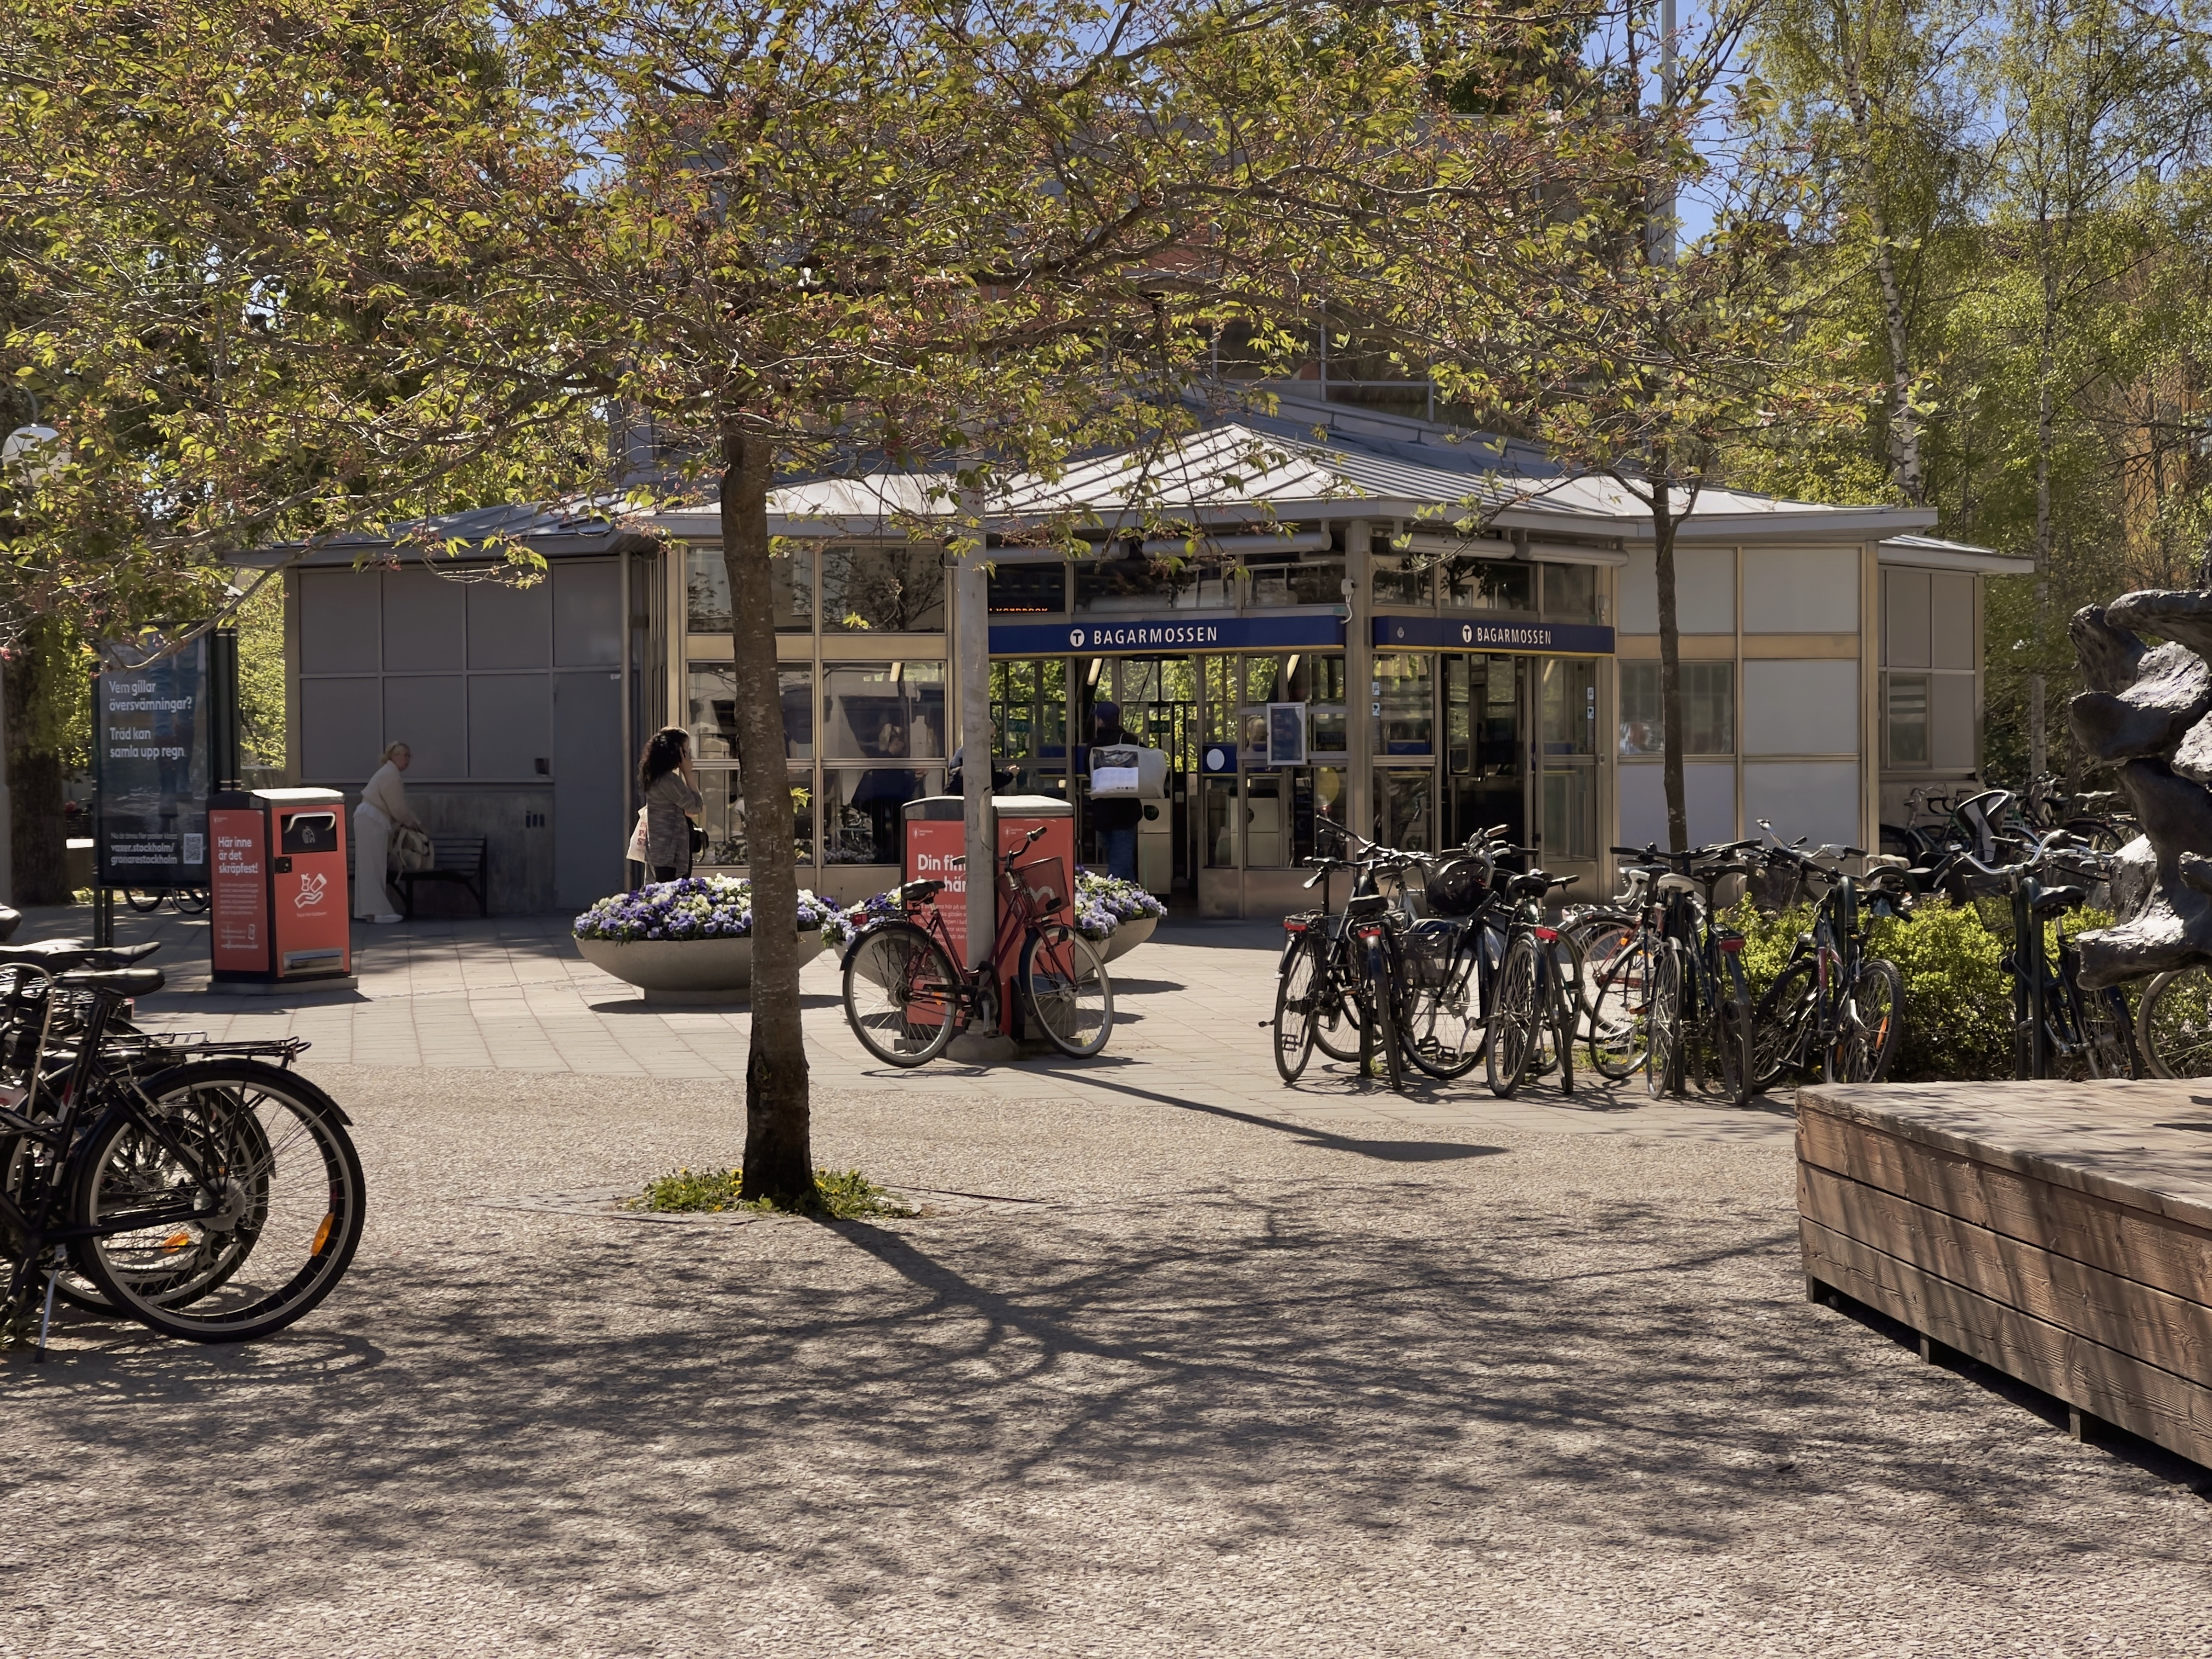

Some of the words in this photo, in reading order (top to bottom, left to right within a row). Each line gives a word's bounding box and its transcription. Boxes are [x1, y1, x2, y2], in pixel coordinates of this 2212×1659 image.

[1093, 627, 1217, 645] BAGARMOSSEN
[1477, 627, 1552, 645] BAGARMOSSEN
[109, 680, 129, 693] Vem
[132, 679, 156, 696] gillar
[109, 696, 192, 713] översvämningar?
[109, 727, 131, 740] Träd
[133, 727, 151, 740] kan
[110, 744, 139, 758] samla
[140, 747, 159, 760] upp
[218, 836, 233, 847] Här
[234, 836, 252, 847] inne
[218, 849, 228, 861] är
[228, 849, 242, 861] det
[918, 854, 941, 871] Din
[218, 862, 258, 876] skräpfest!
